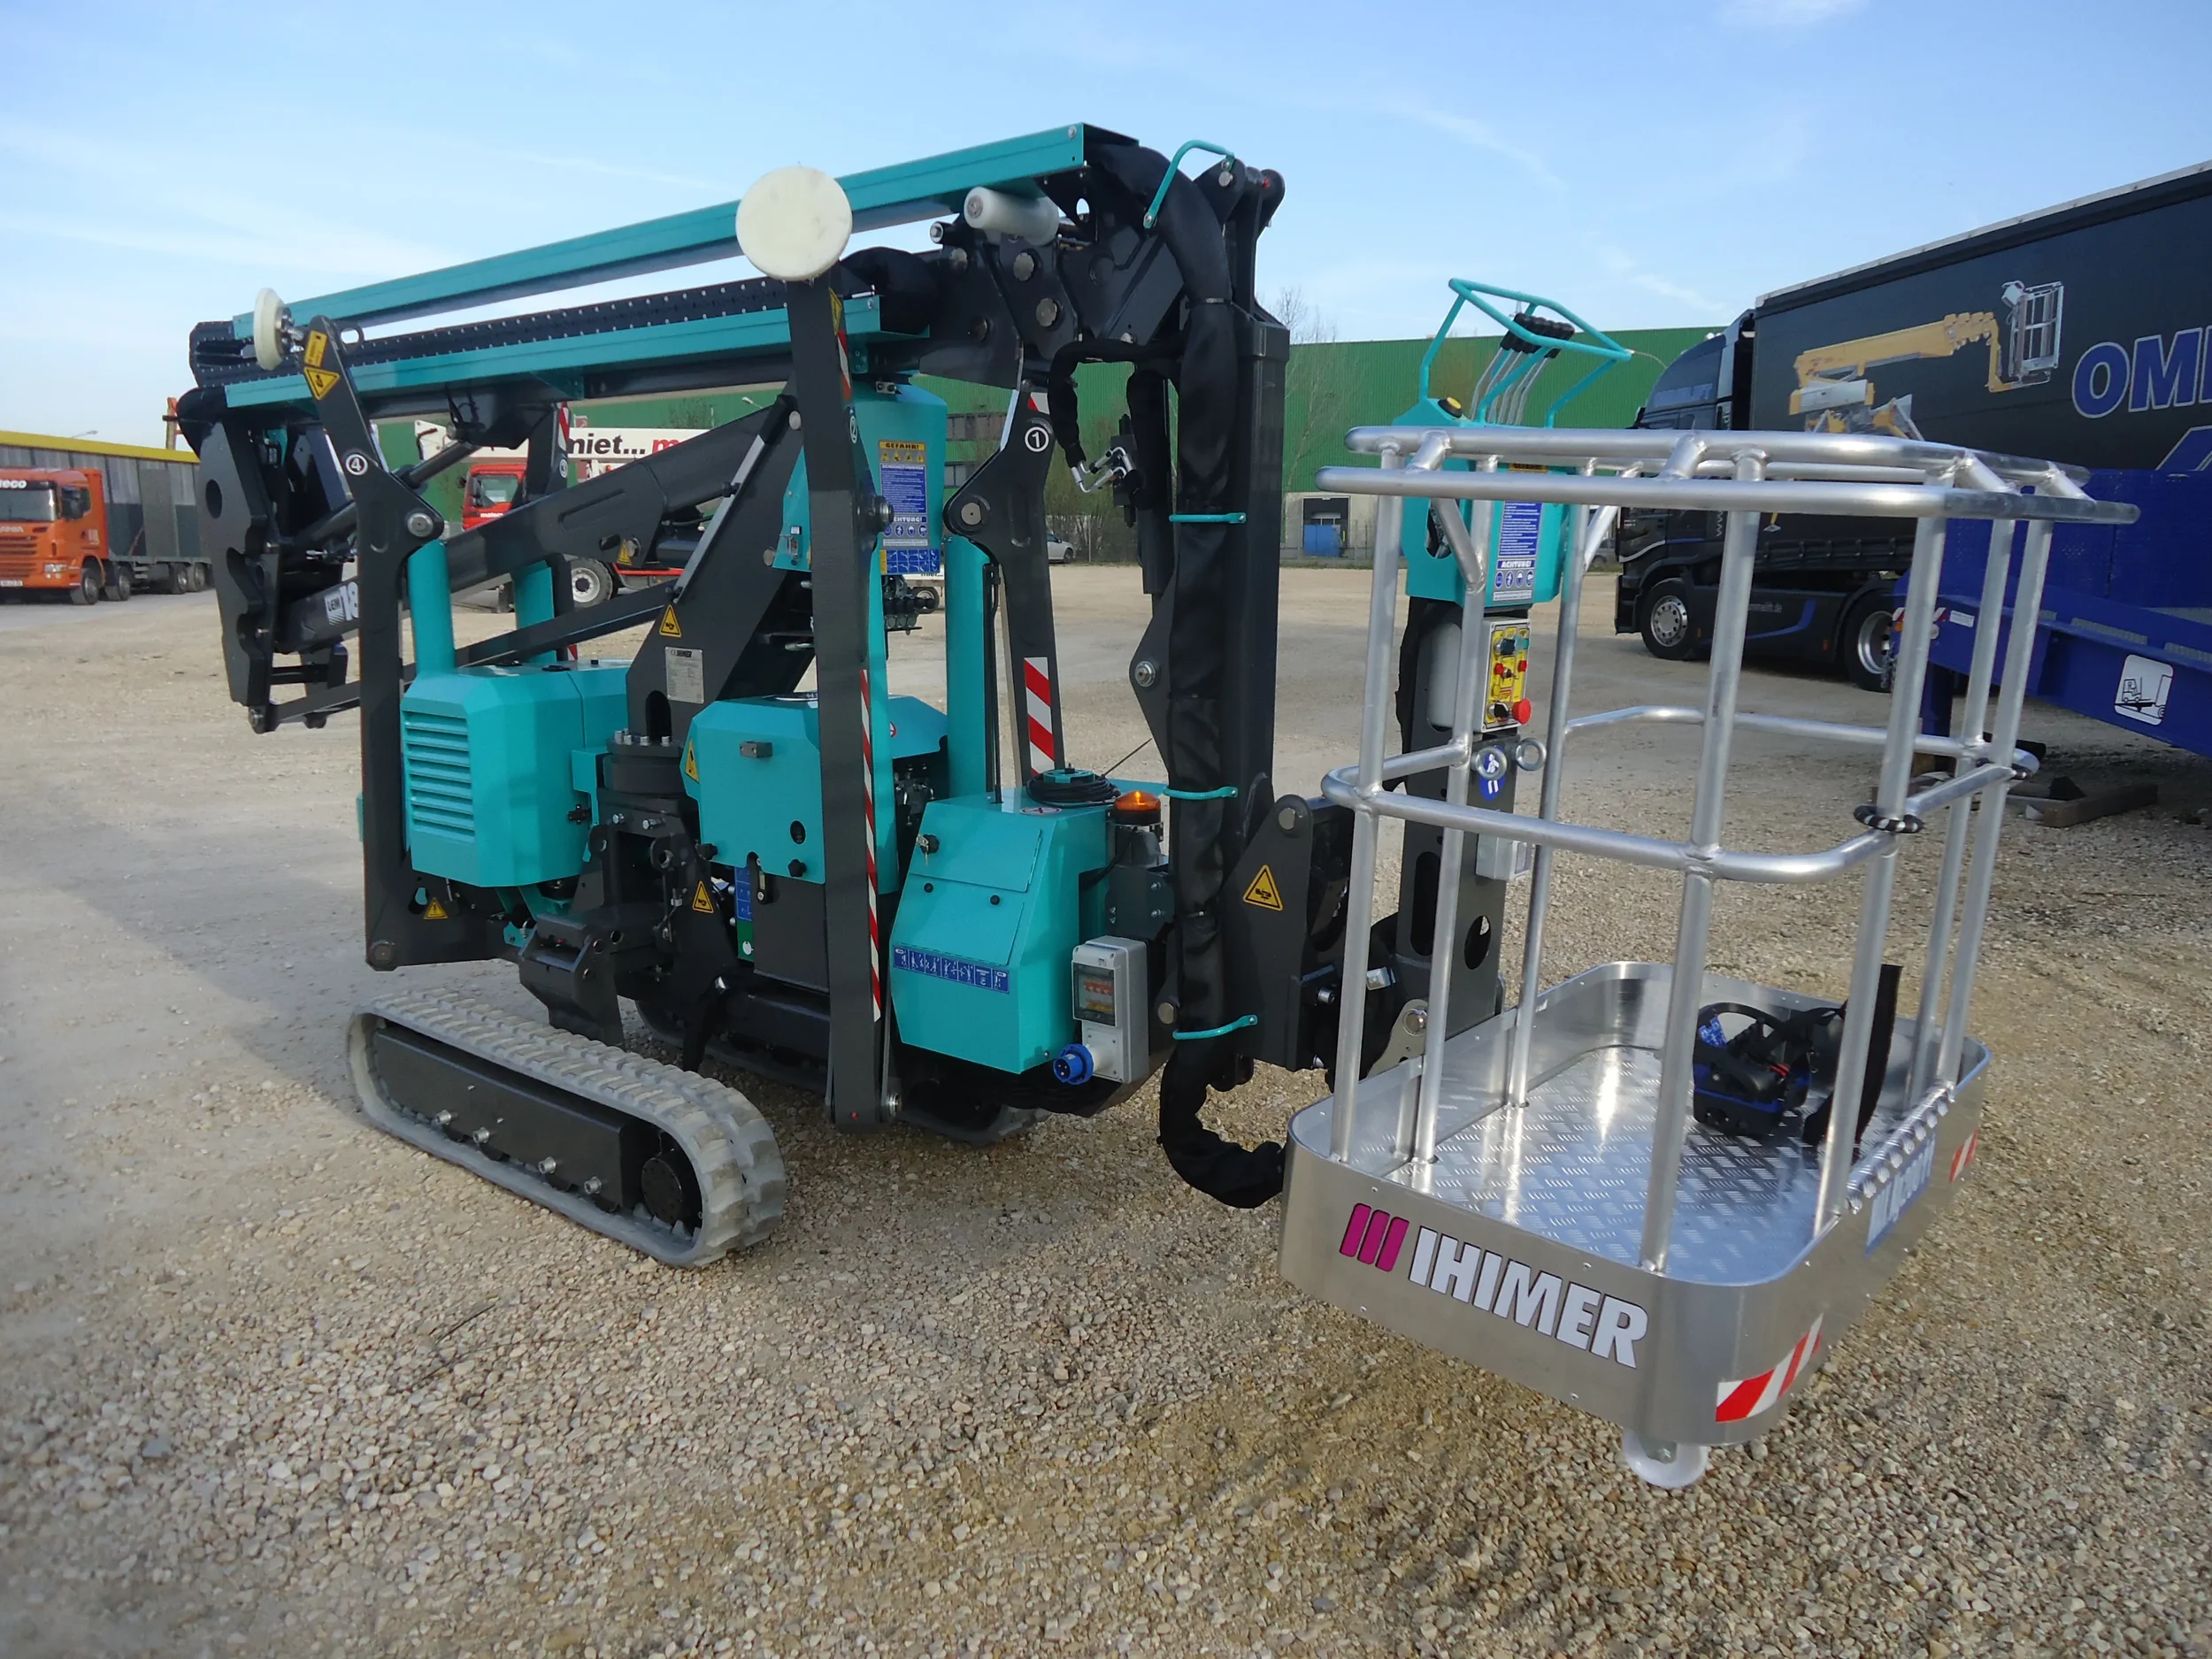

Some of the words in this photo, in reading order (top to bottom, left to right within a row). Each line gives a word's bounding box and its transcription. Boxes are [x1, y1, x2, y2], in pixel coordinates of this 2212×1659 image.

[2071, 325, 2212, 419] OM
[0, 480, 27, 488] eco
[1501, 560, 1532, 569] ACHTUNG!
[1409, 1225, 1649, 1370] IHIMER
